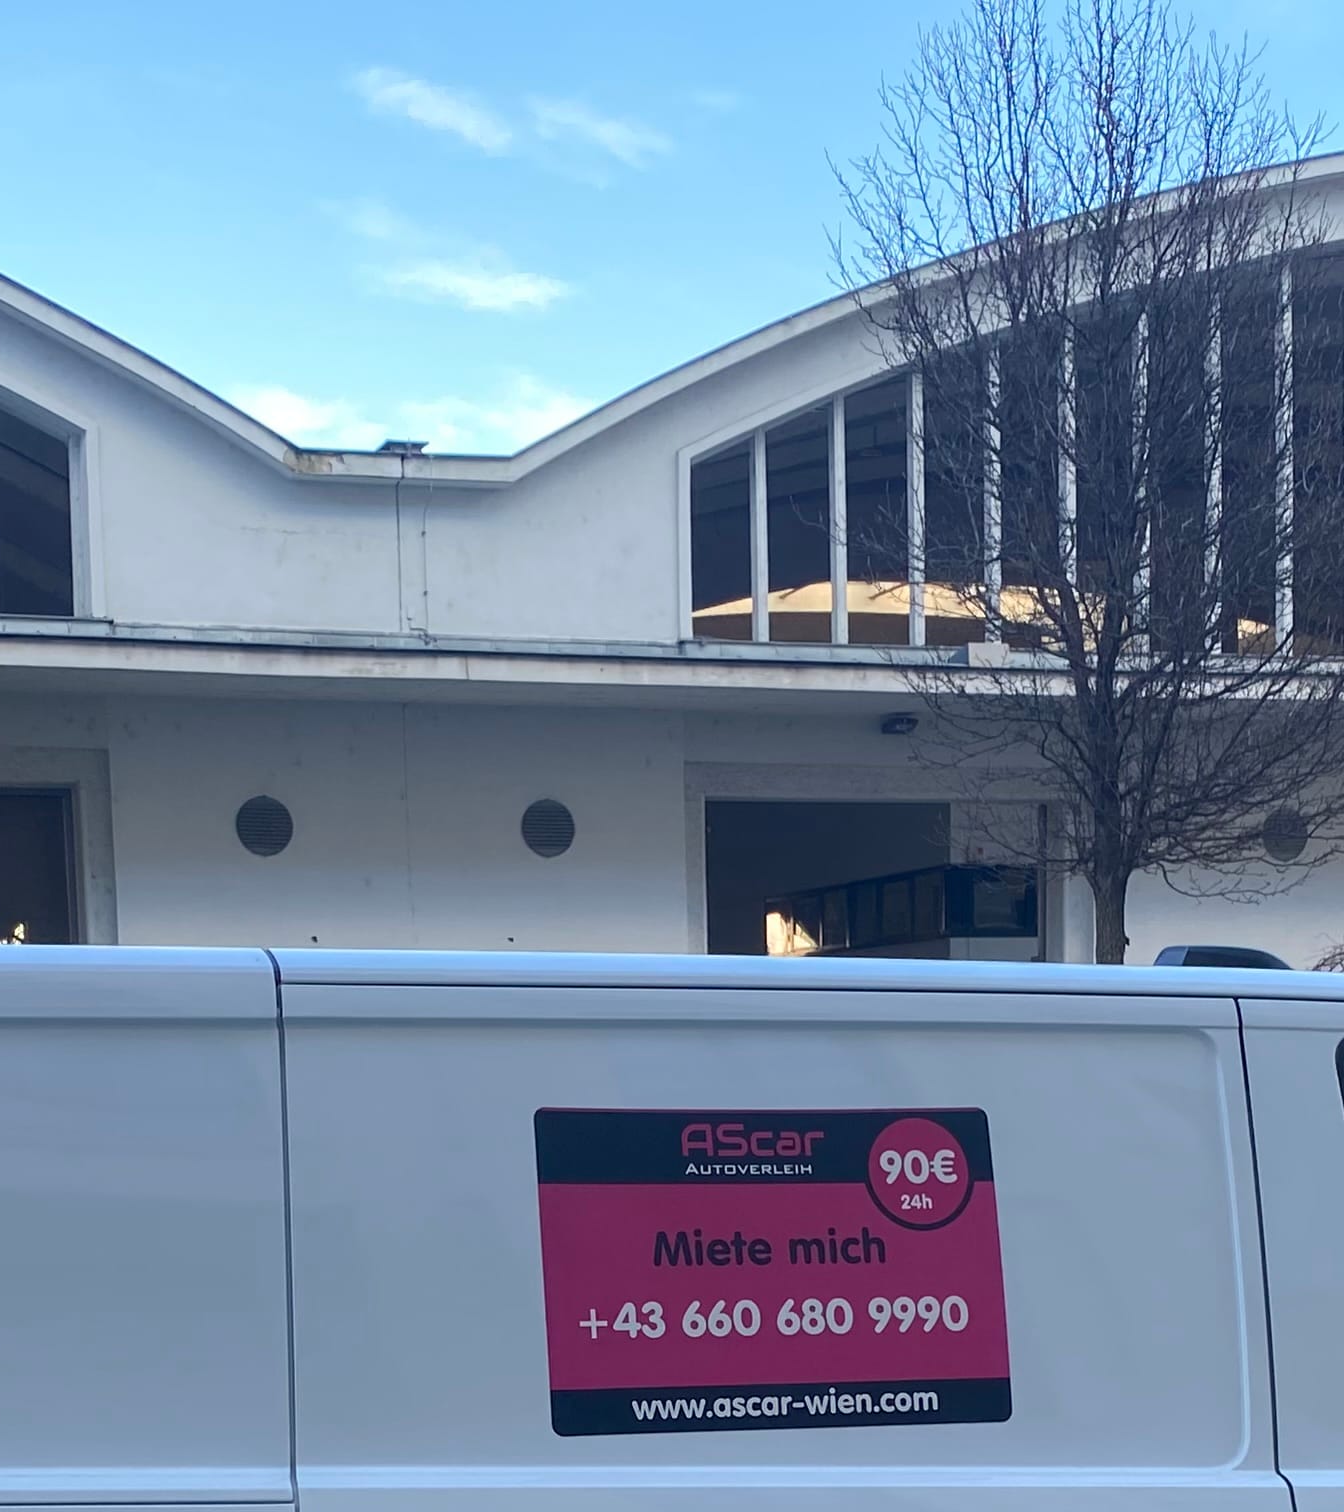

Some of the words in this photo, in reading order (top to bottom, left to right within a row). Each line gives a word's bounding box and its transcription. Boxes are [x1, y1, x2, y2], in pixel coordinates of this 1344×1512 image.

[681, 1122, 824, 1158] AScar
[685, 1161, 813, 1176] AUTOVERLEIH
[878, 1149, 958, 1185] 90€
[900, 1193, 933, 1210] 24h
[653, 1230, 772, 1267] Miete
[789, 1227, 887, 1264] mich
[578, 1301, 666, 1340] +43
[681, 1299, 761, 1338] 660
[776, 1298, 854, 1336] 680
[867, 1295, 969, 1335] 9990
[631, 1387, 939, 1421] www.ascar-wien.com
